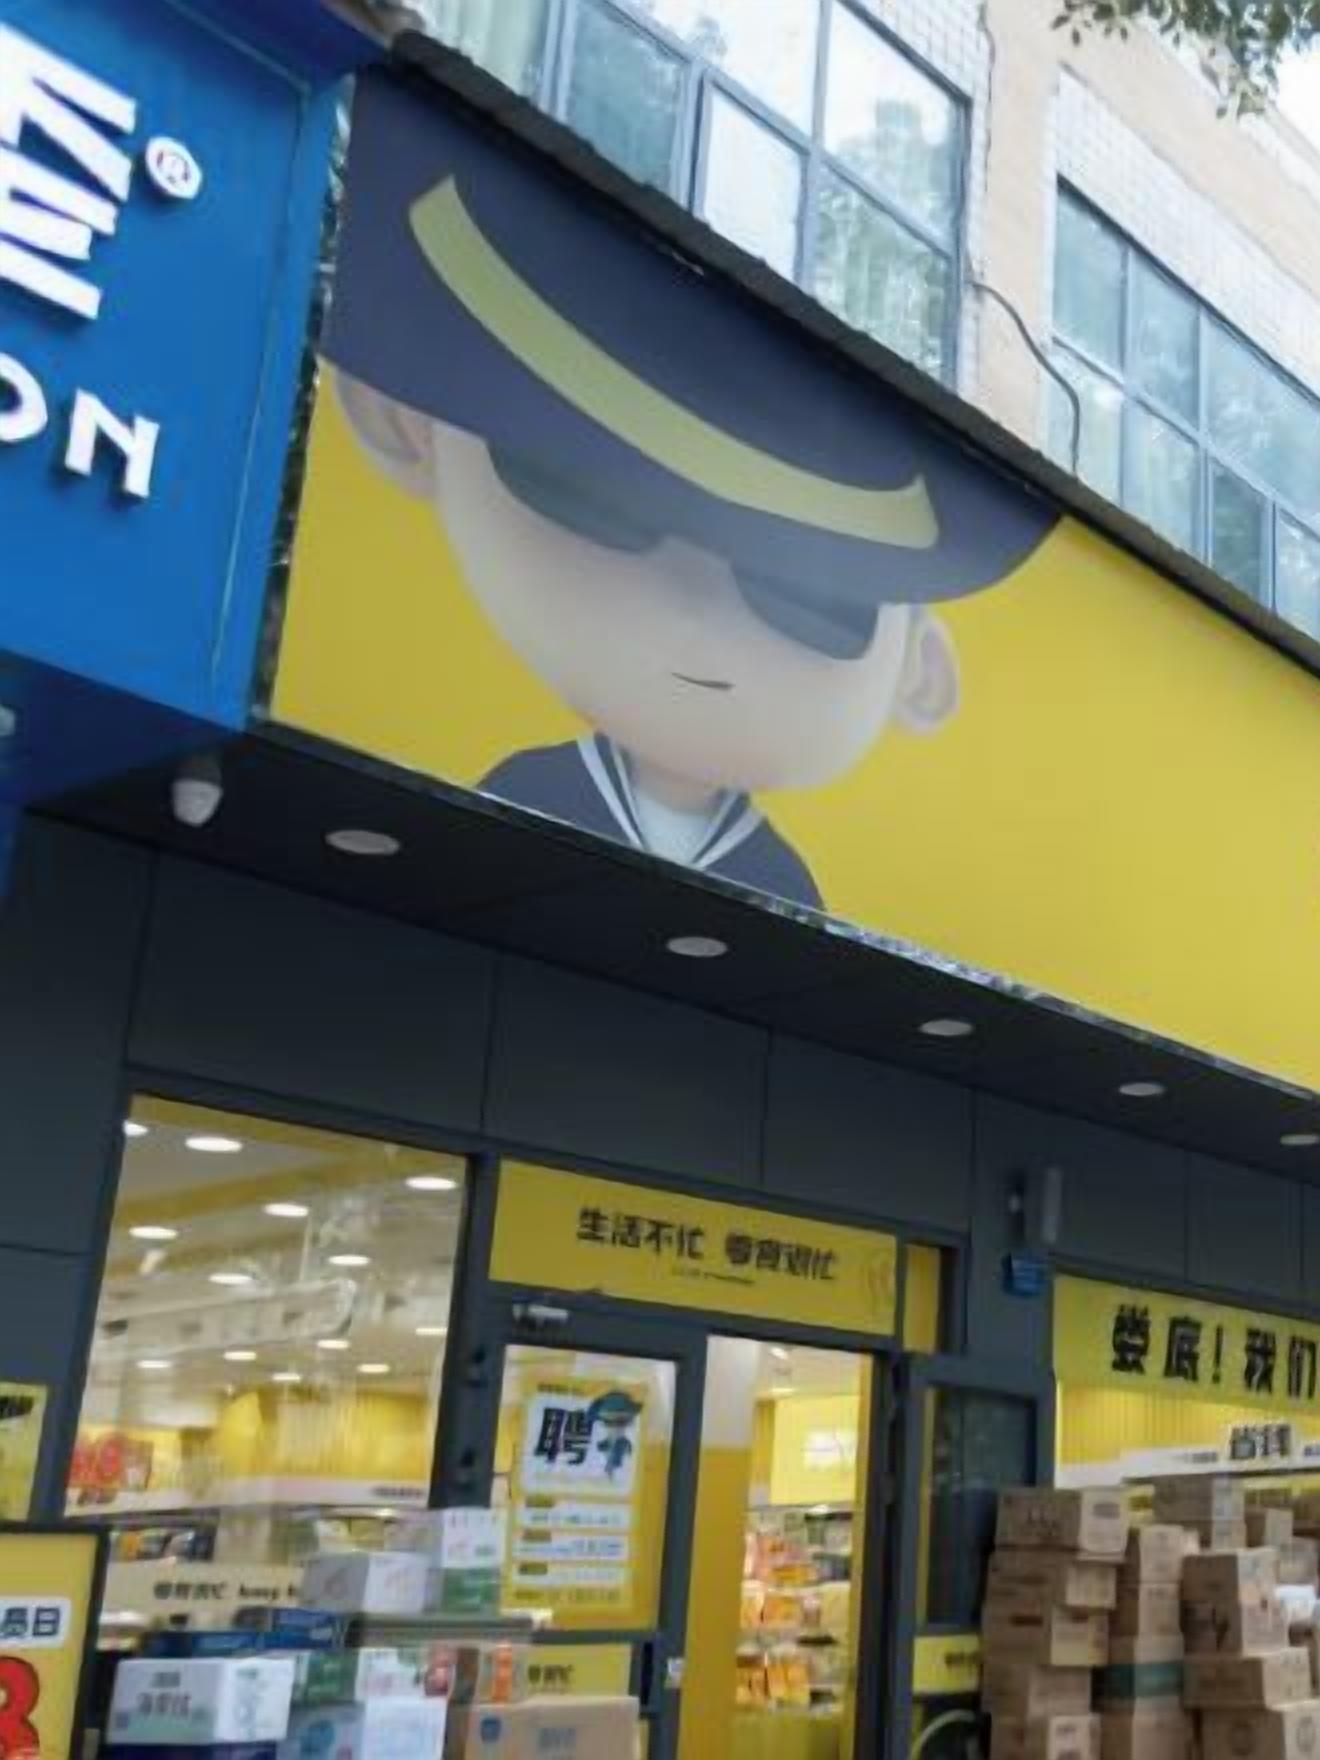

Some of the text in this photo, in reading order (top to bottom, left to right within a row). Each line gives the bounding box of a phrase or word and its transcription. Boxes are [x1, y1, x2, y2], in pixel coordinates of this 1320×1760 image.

[577, 1206, 836, 1281] 生活不忙 零食很忙
[533, 1406, 590, 1466] 聘
